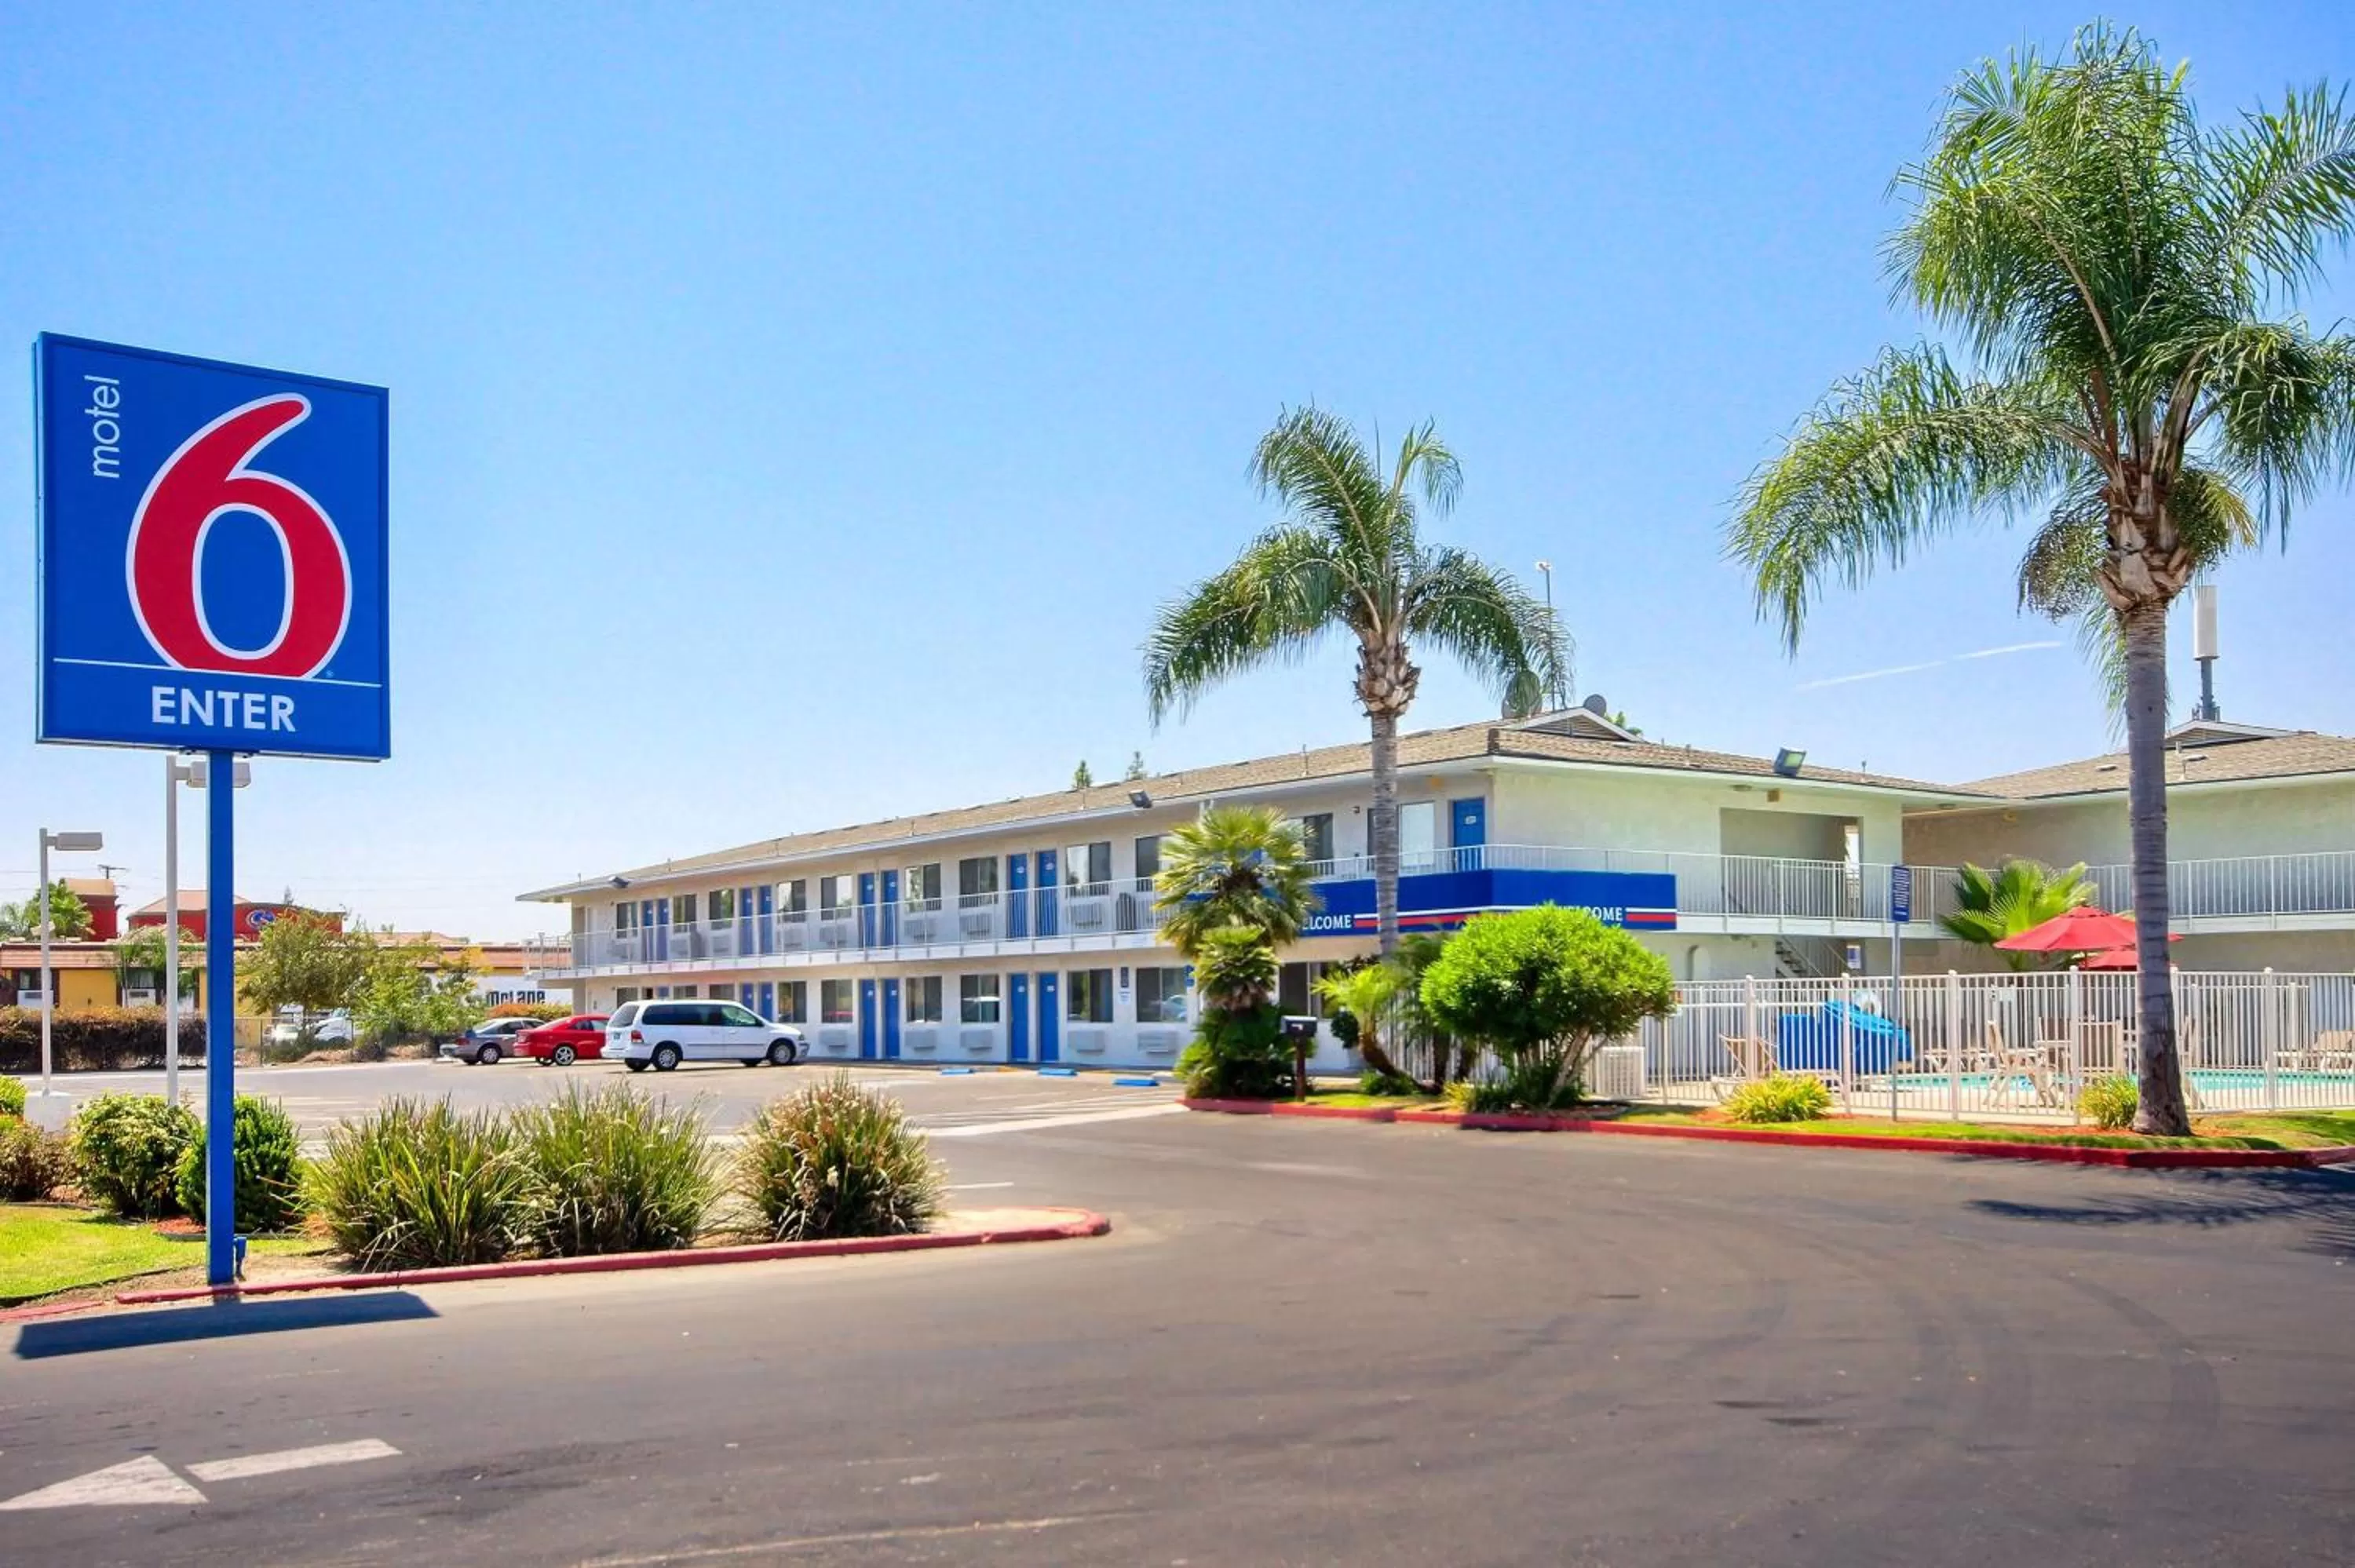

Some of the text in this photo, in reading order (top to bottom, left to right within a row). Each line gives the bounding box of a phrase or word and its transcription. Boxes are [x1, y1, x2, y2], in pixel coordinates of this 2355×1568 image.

[84, 374, 120, 478] motel
[126, 392, 352, 680] 6
[152, 686, 296, 732] ENTER
